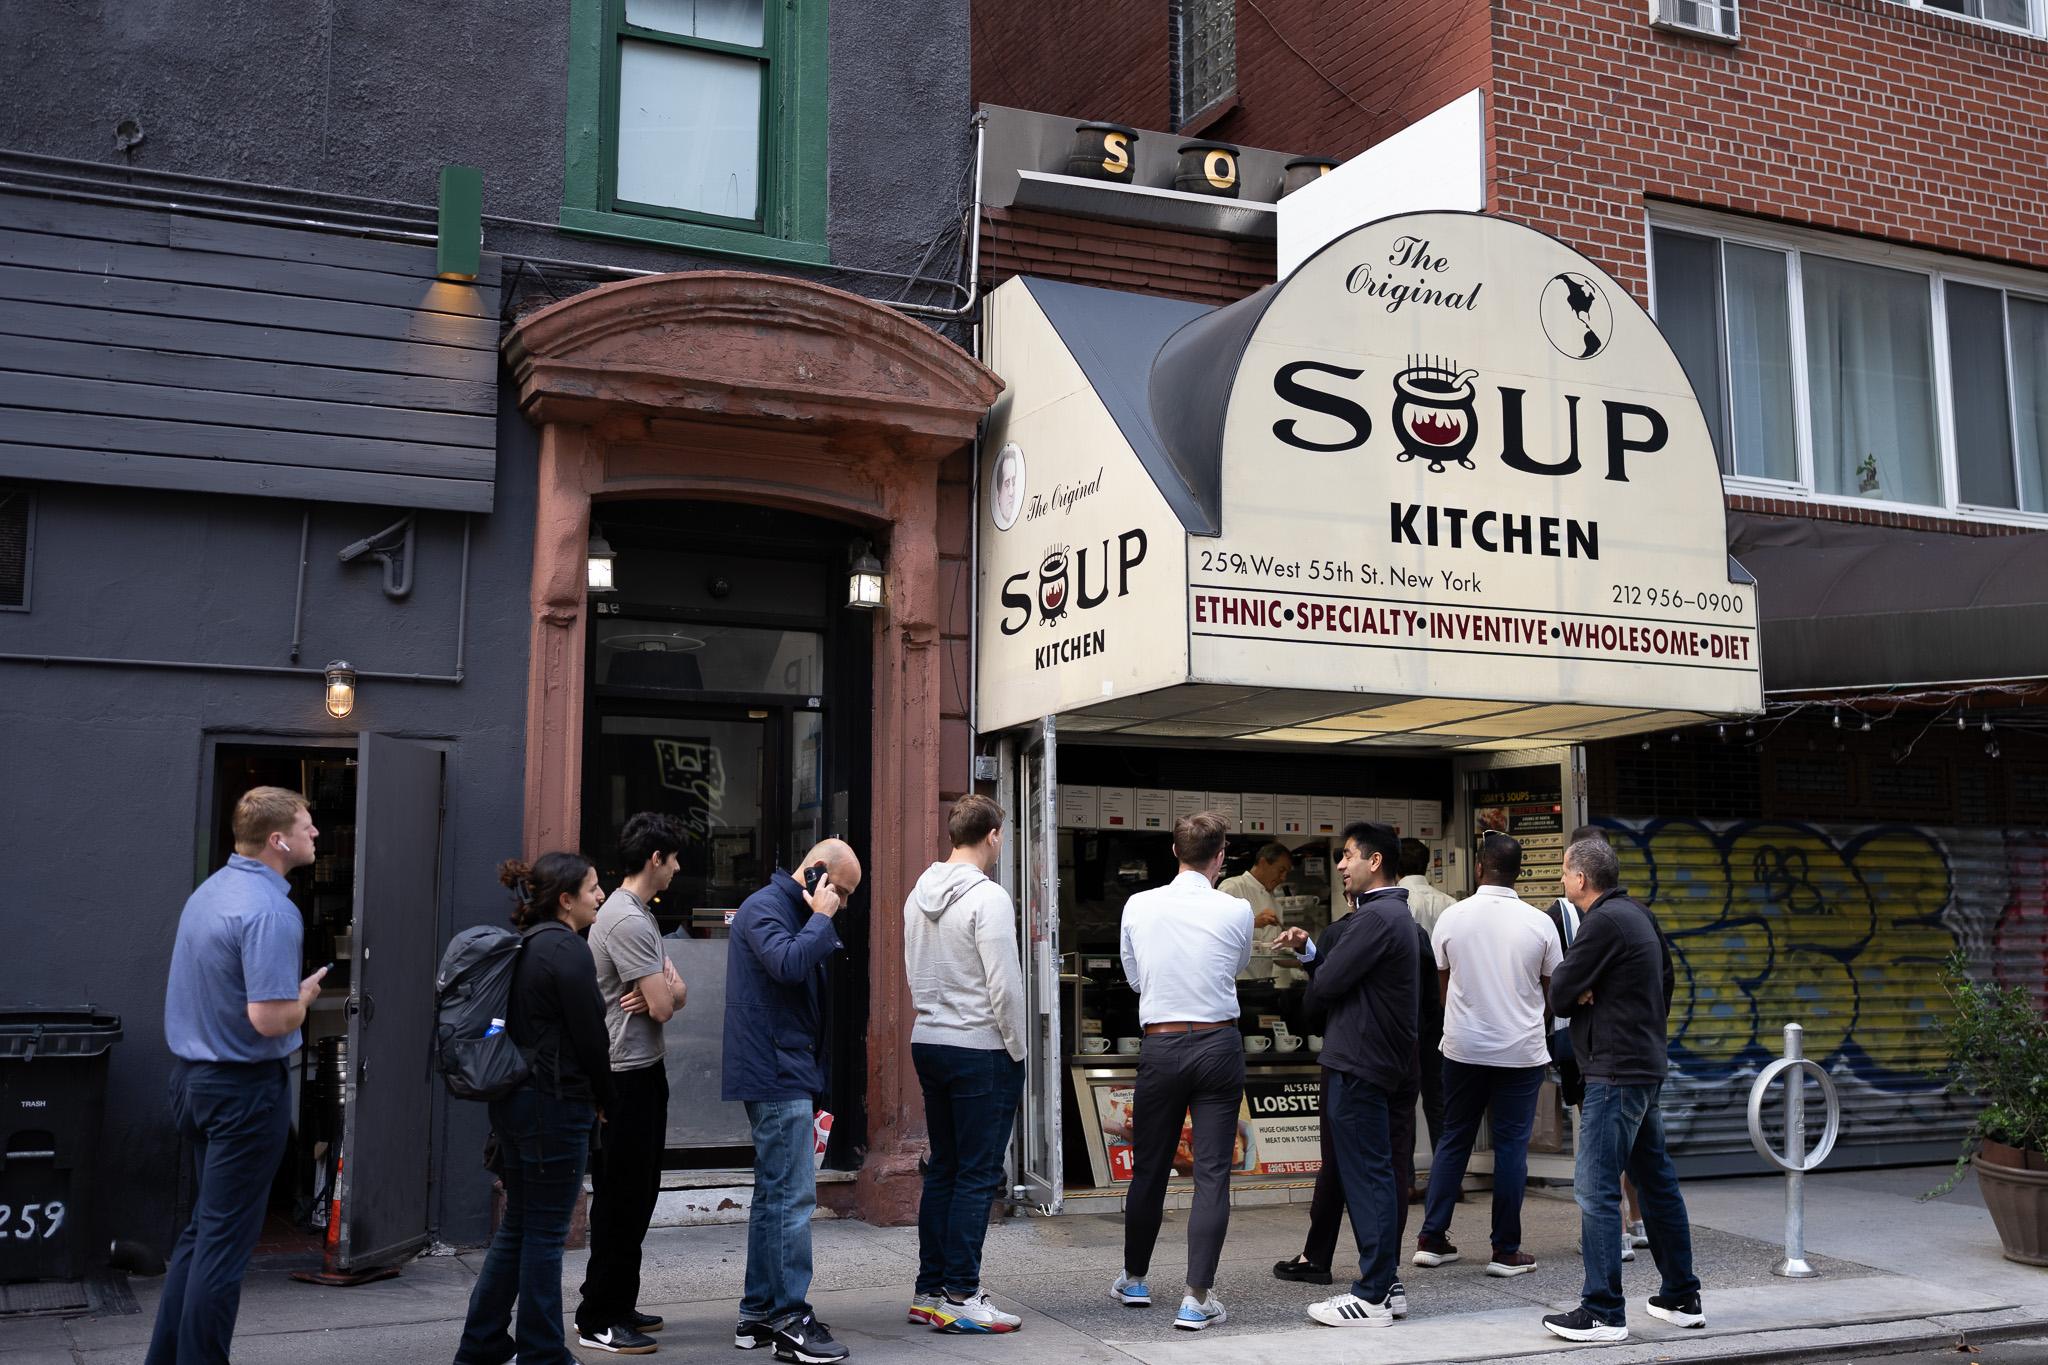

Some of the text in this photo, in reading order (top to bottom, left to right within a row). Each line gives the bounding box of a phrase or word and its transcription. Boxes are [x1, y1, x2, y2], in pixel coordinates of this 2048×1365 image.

[1102, 132, 1235, 188] S O
[1388, 235, 1450, 273] The
[1345, 262, 1483, 314] Original
[1272, 354, 1669, 482] SOUP
[1026, 466, 1104, 522] The Original
[1390, 502, 1599, 560] KITCHEN
[1000, 528, 1148, 636] SOUP
[1250, 554, 1301, 578] West
[1308, 560, 1353, 583] 55th
[1361, 564, 1384, 585] St.
[1390, 566, 1434, 588] New
[1441, 570, 1482, 593] York
[1612, 584, 1641, 605] 212
[1195, 595, 1750, 661] ETHNIC SPECIALTY INVENTIVE WHOLESOME DIET
[1035, 629, 1105, 671] KITCHEN
[21, 1100, 46, 1108] TRASH
[1253, 1095, 1320, 1112] LOBSTE
[1284, 1083, 1320, 1092] AL'S FAM
[1115, 1149, 1134, 1170] $1
[1285, 1161, 1322, 1172] THE BES
[0, 1201, 65, 1239] 259
